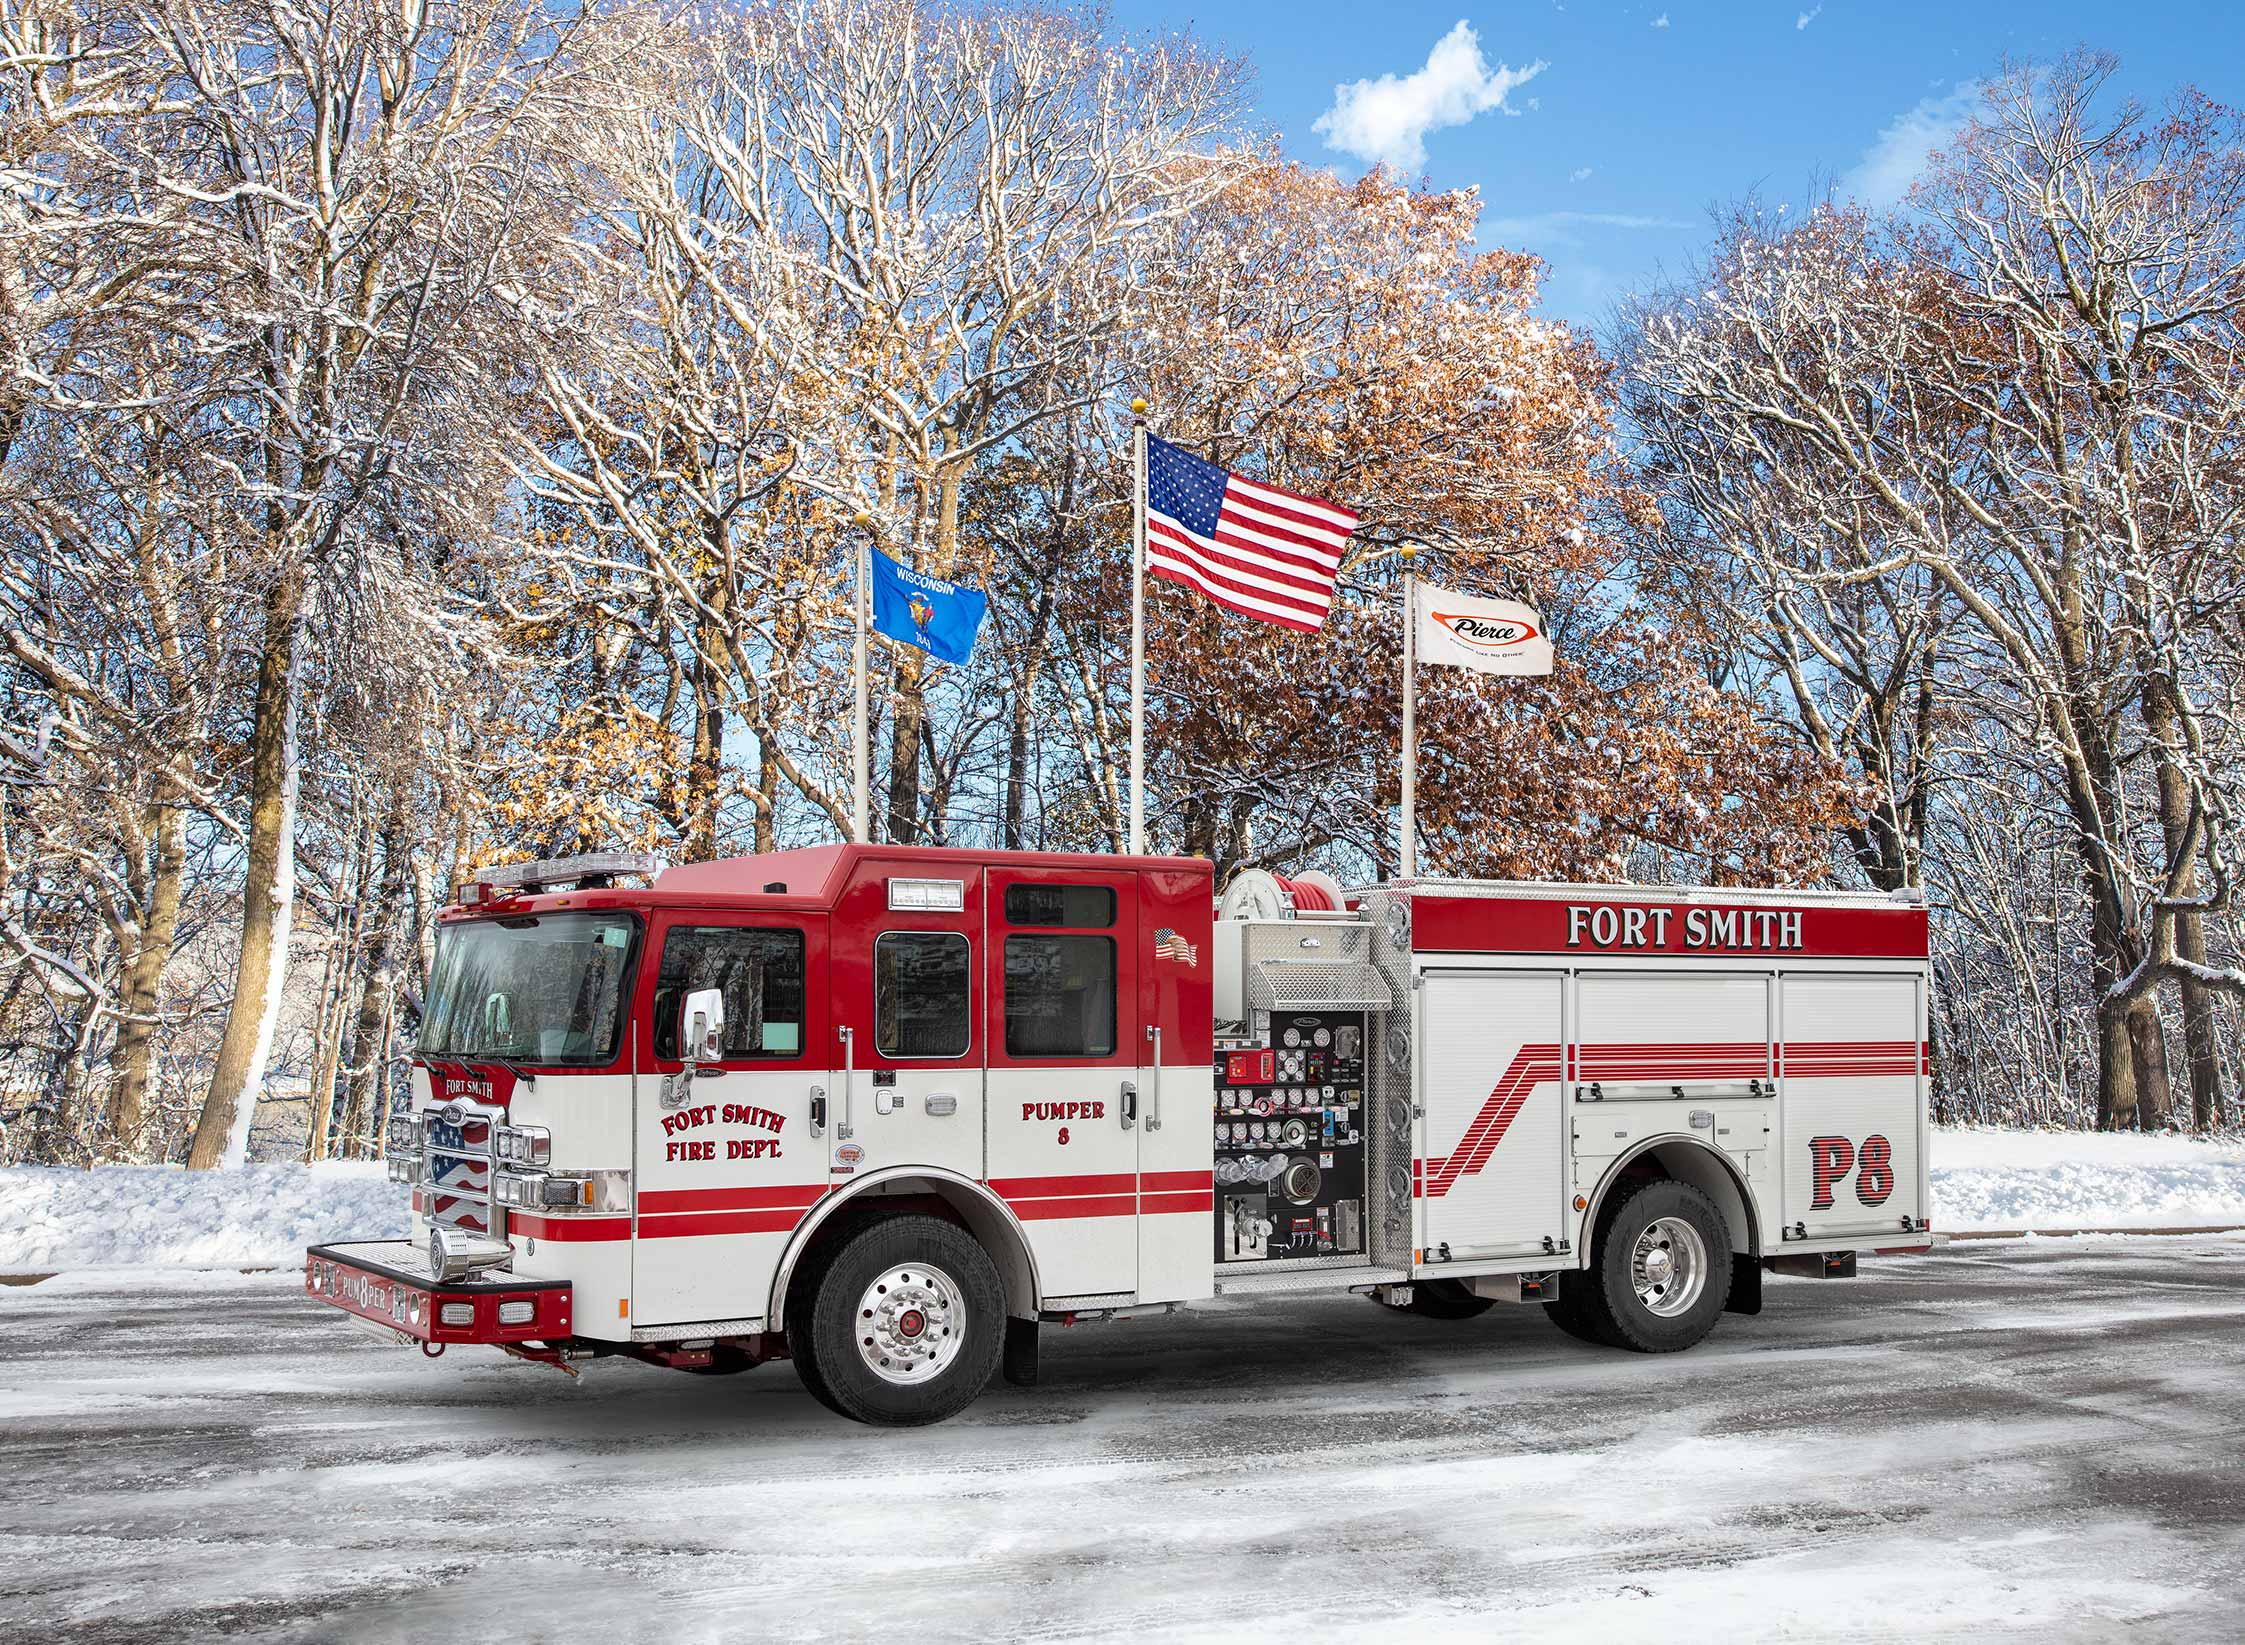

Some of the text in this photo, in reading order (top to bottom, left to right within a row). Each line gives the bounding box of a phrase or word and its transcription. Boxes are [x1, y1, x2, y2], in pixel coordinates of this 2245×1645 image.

[896, 567, 955, 596] WISCONSIN
[1454, 619, 1515, 639] Pierce
[1566, 906, 1804, 951] FORT SMITH
[445, 1079, 493, 1100] FORT SMITH
[661, 1103, 787, 1137] FORT SMITH
[1022, 1101, 1105, 1121] PUMPER
[1057, 1126, 1070, 1146] 8
[665, 1139, 783, 1162] FIRE DEPT.
[1807, 1134, 1895, 1211] P8
